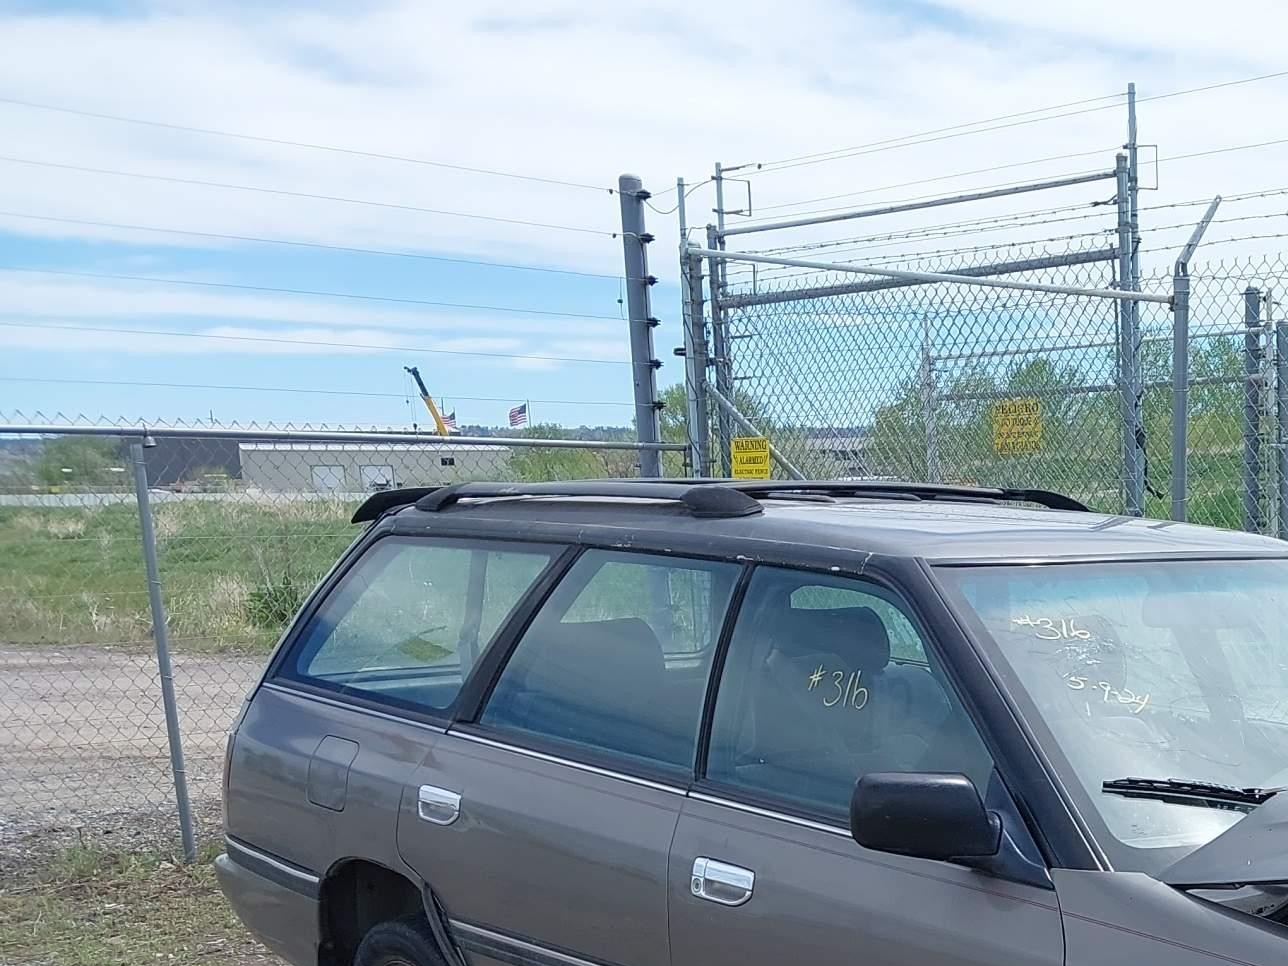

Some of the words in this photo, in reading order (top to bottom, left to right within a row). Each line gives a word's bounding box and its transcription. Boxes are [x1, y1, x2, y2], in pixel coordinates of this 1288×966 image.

[734, 440, 767, 451] WARNING
[1012, 614, 1091, 640] #316
[808, 664, 869, 710] #316
